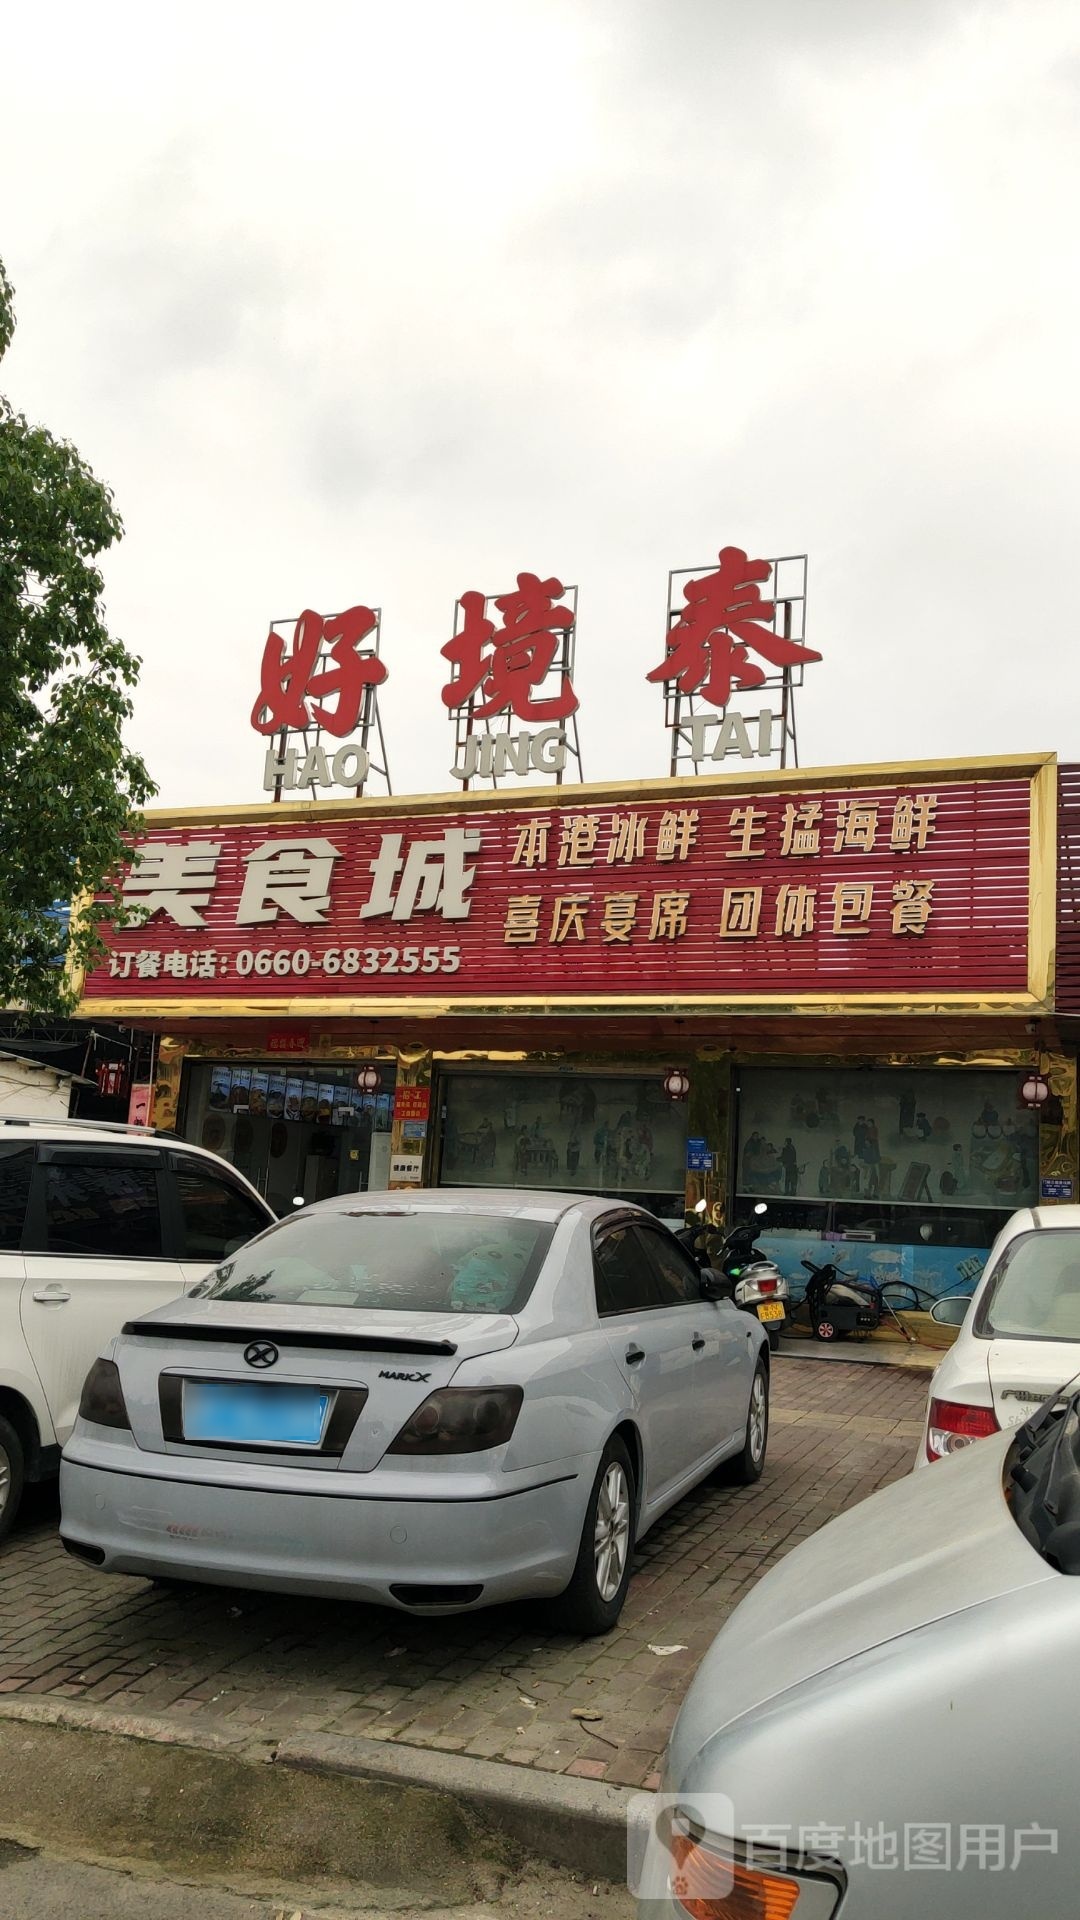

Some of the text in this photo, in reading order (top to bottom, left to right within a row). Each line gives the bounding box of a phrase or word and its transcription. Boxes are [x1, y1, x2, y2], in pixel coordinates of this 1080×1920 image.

[251, 546, 823, 737] 好境泰
[264, 708, 773, 791] HAO JING TAI
[118, 828, 484, 928] 美食城
[512, 809, 699, 868] 本港冰鲜
[503, 879, 936, 944] 喜庆宴席 团体包餐
